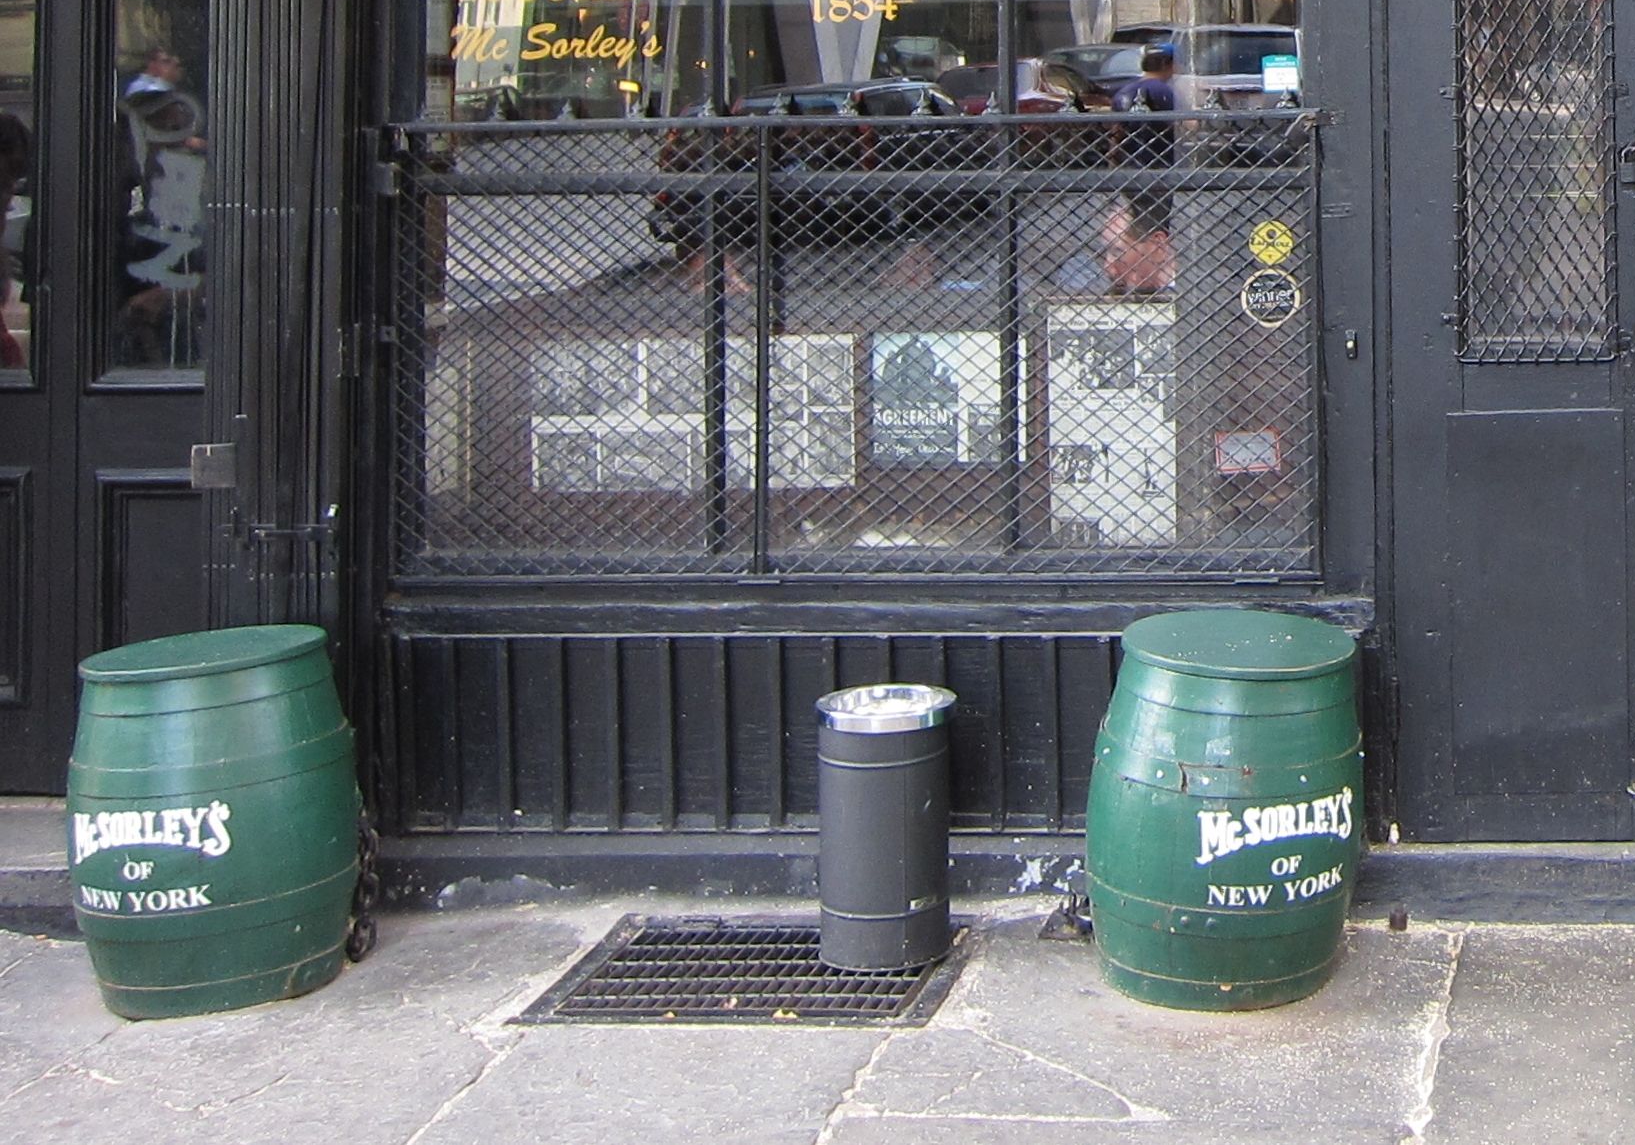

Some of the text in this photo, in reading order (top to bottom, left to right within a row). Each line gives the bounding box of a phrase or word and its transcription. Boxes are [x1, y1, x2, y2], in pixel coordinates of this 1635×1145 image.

[450, 20, 663, 69] Mc Sorley's
[122, 861, 154, 880] OF
[1271, 855, 1303, 876] OF
[81, 884, 212, 912] NEW YORK
[1207, 863, 1343, 906] NEW YORK
